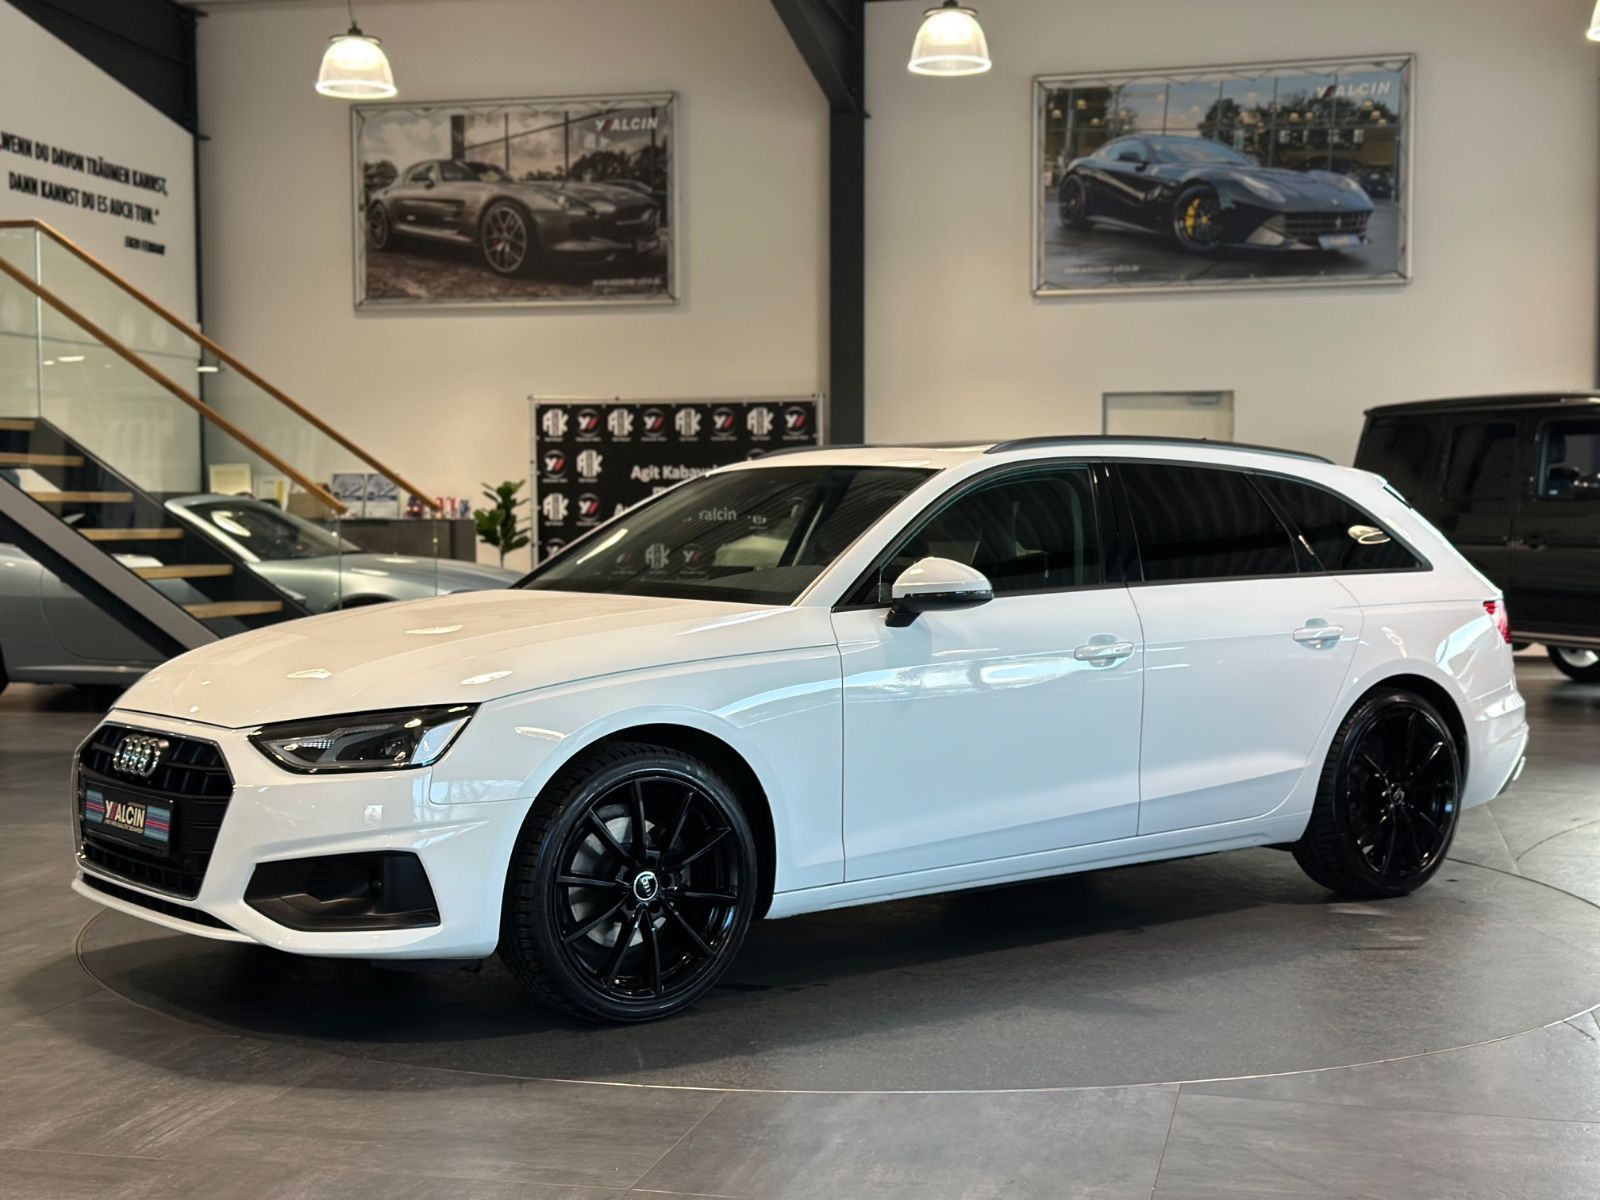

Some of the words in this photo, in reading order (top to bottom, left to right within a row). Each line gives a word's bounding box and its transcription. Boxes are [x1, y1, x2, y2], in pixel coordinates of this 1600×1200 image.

[35, 142, 49, 162] DU
[51, 146, 84, 172] DAVON
[86, 156, 130, 185] TRÄUMEN
[8, 171, 38, 195] DANN
[41, 179, 79, 206] KANNST
[82, 190, 95, 210] DU
[97, 194, 108, 213] ES
[110, 198, 133, 219] AUCH
[630, 465, 660, 483] Agit
